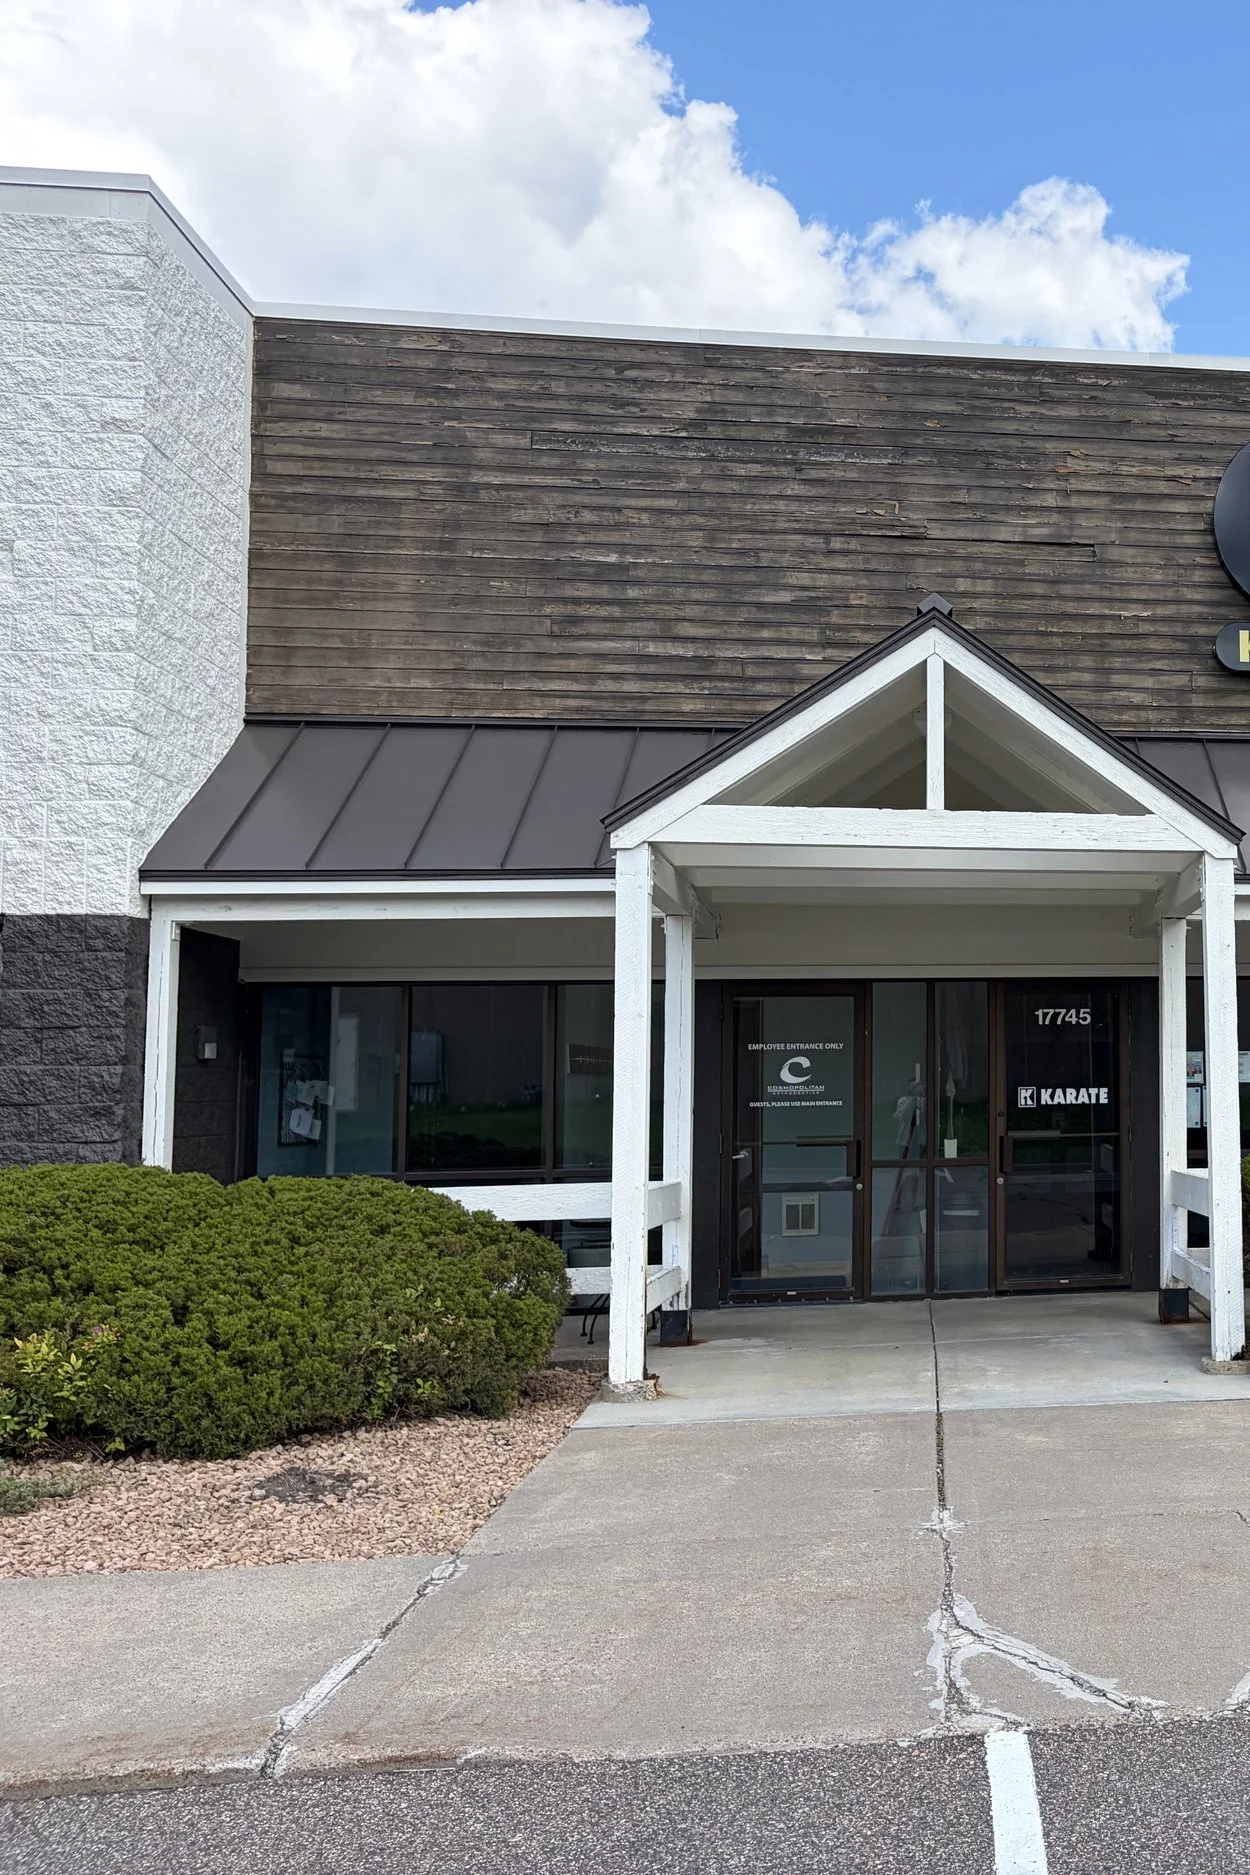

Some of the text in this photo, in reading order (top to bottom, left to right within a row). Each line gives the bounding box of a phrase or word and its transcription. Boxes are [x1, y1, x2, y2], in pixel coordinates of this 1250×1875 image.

[1034, 1008, 1091, 1025] 17745
[825, 1042, 844, 1050] ONLY
[1040, 1088, 1108, 1105] KARATE
